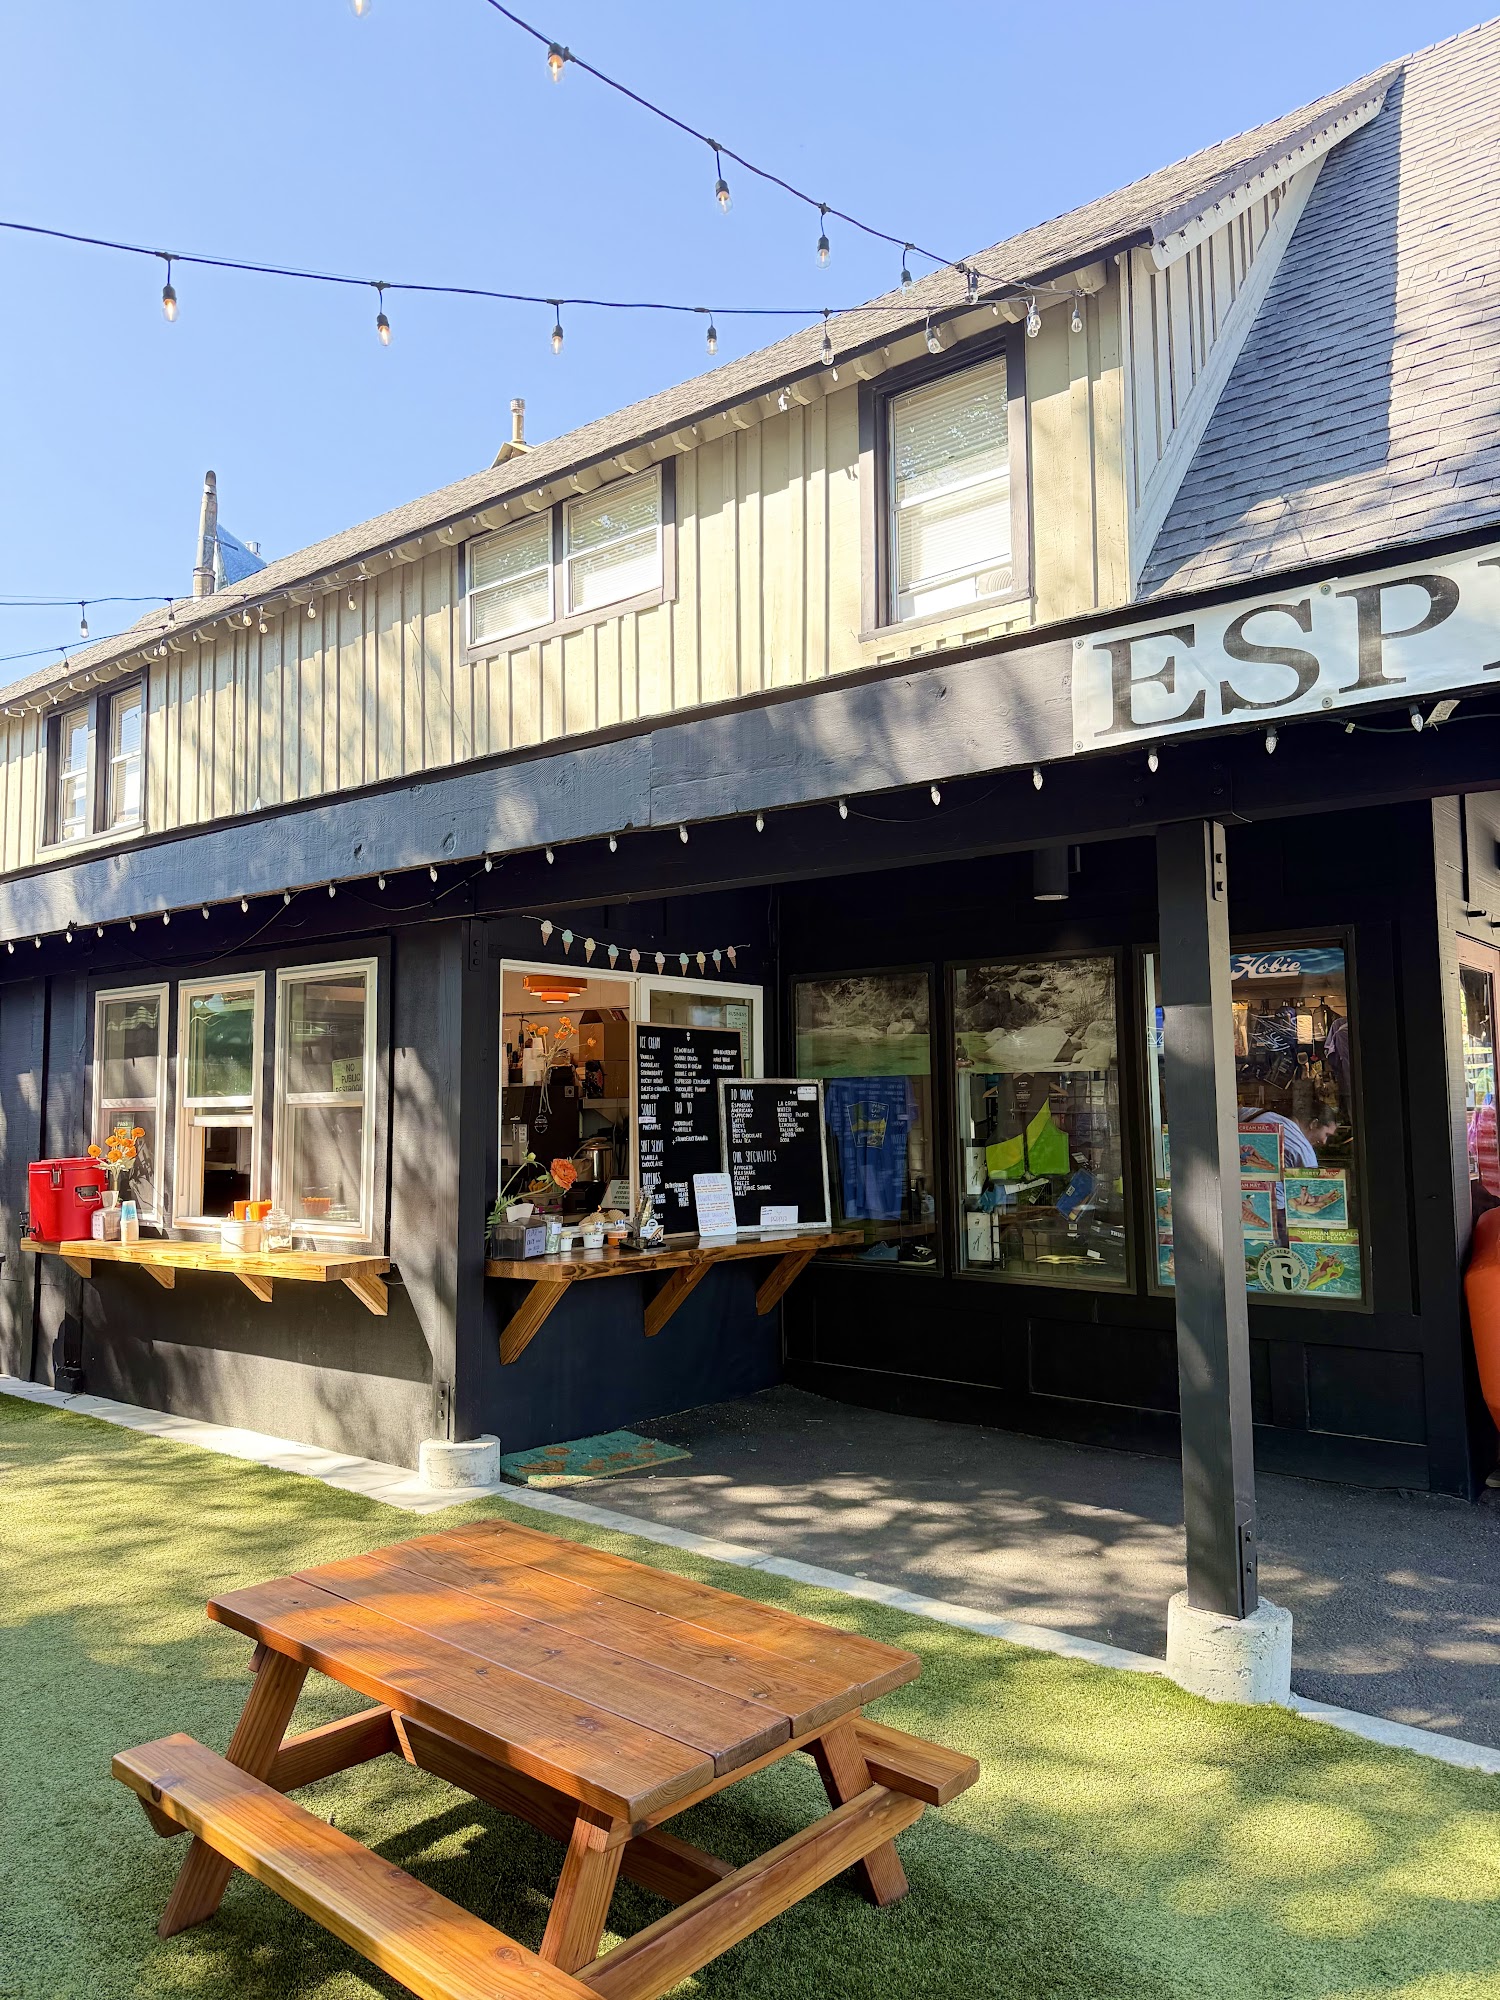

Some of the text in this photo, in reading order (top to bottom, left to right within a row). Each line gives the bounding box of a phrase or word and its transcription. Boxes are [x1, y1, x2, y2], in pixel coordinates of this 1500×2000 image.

[1092, 557, 1500, 737] ESP
[1231, 954, 1302, 979] Hobie
[346, 1063, 355, 1072] NO
[341, 1073, 361, 1084] PUBLIC
[731, 1089, 737, 1100] TO
